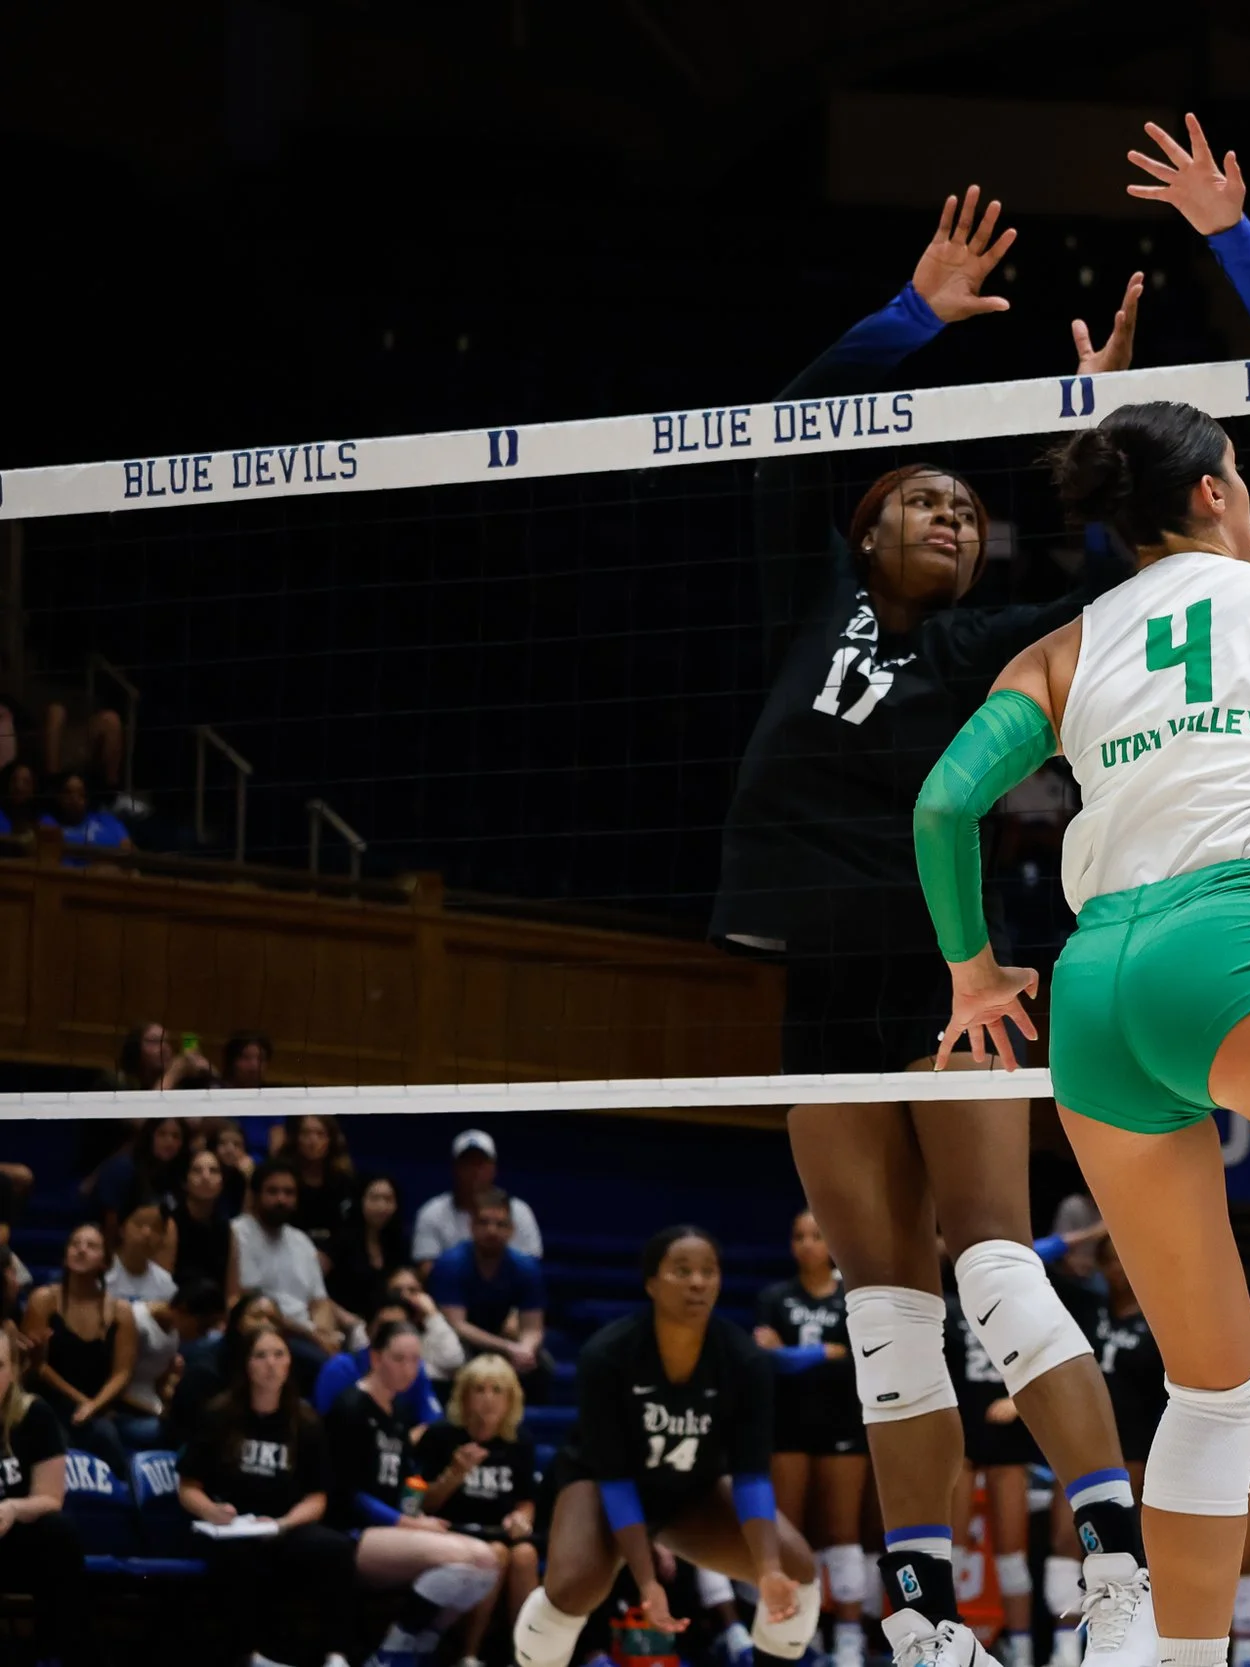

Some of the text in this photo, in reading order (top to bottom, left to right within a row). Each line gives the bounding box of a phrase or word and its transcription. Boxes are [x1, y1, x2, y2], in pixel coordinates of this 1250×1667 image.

[653, 393, 913, 455] BLUE DEVILS
[124, 442, 357, 499] BLUE DEVILS
[1145, 598, 1213, 705] 4
[812, 647, 895, 725] 17
[643, 1401, 713, 1436] Duke
[65, 1455, 113, 1495] UKE
[645, 1434, 700, 1472] 14
